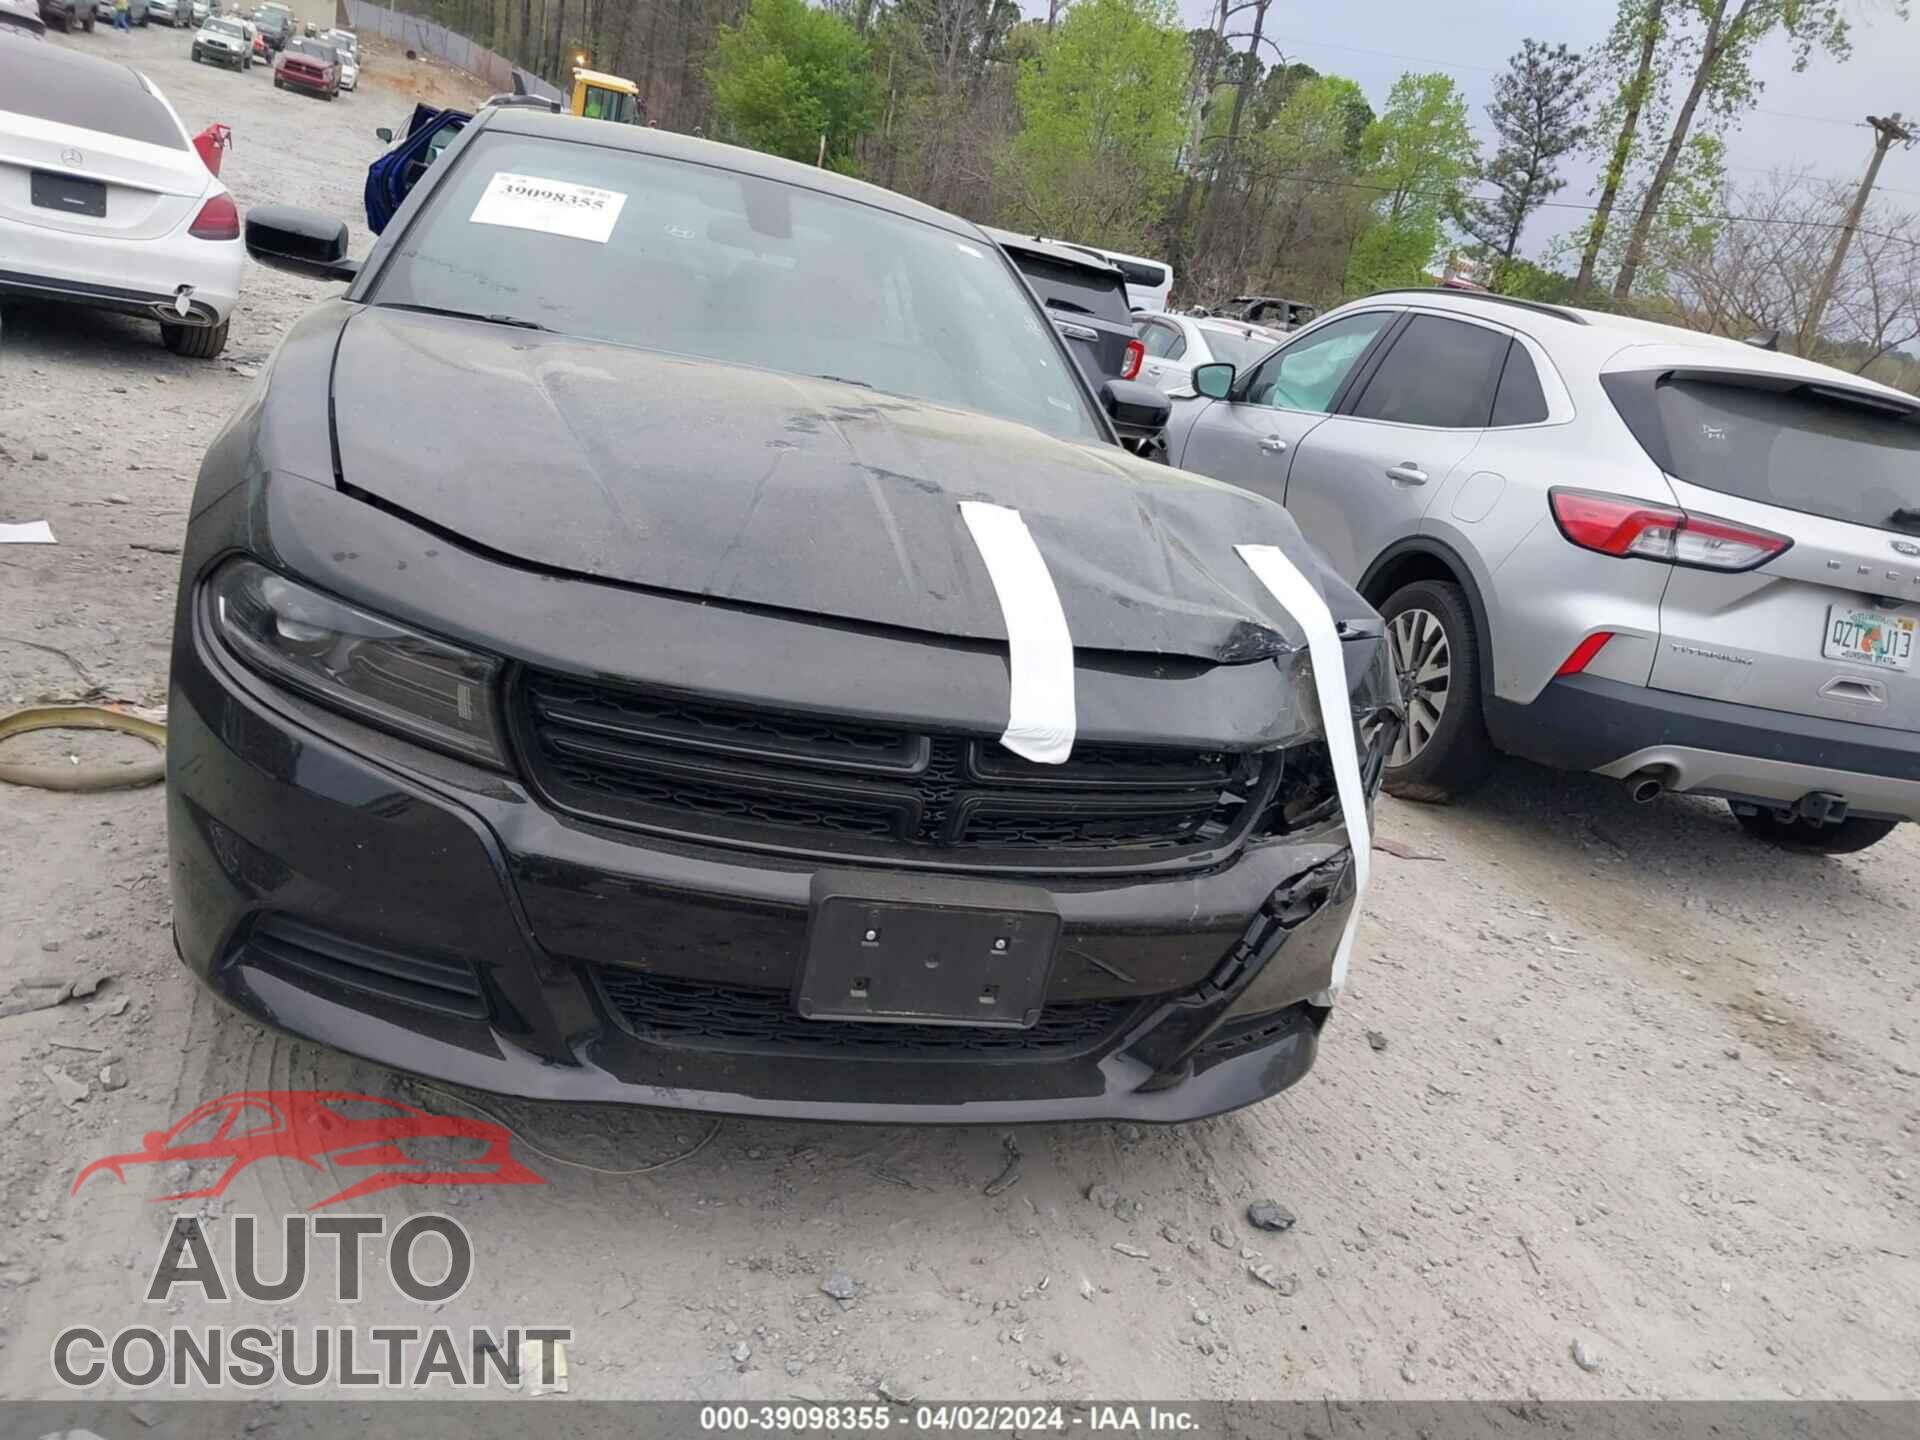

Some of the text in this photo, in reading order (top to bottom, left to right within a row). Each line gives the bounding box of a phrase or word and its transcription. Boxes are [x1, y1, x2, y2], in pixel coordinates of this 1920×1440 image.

[505, 184, 606, 209] 39098355
[1832, 619, 1912, 658] QZT J13
